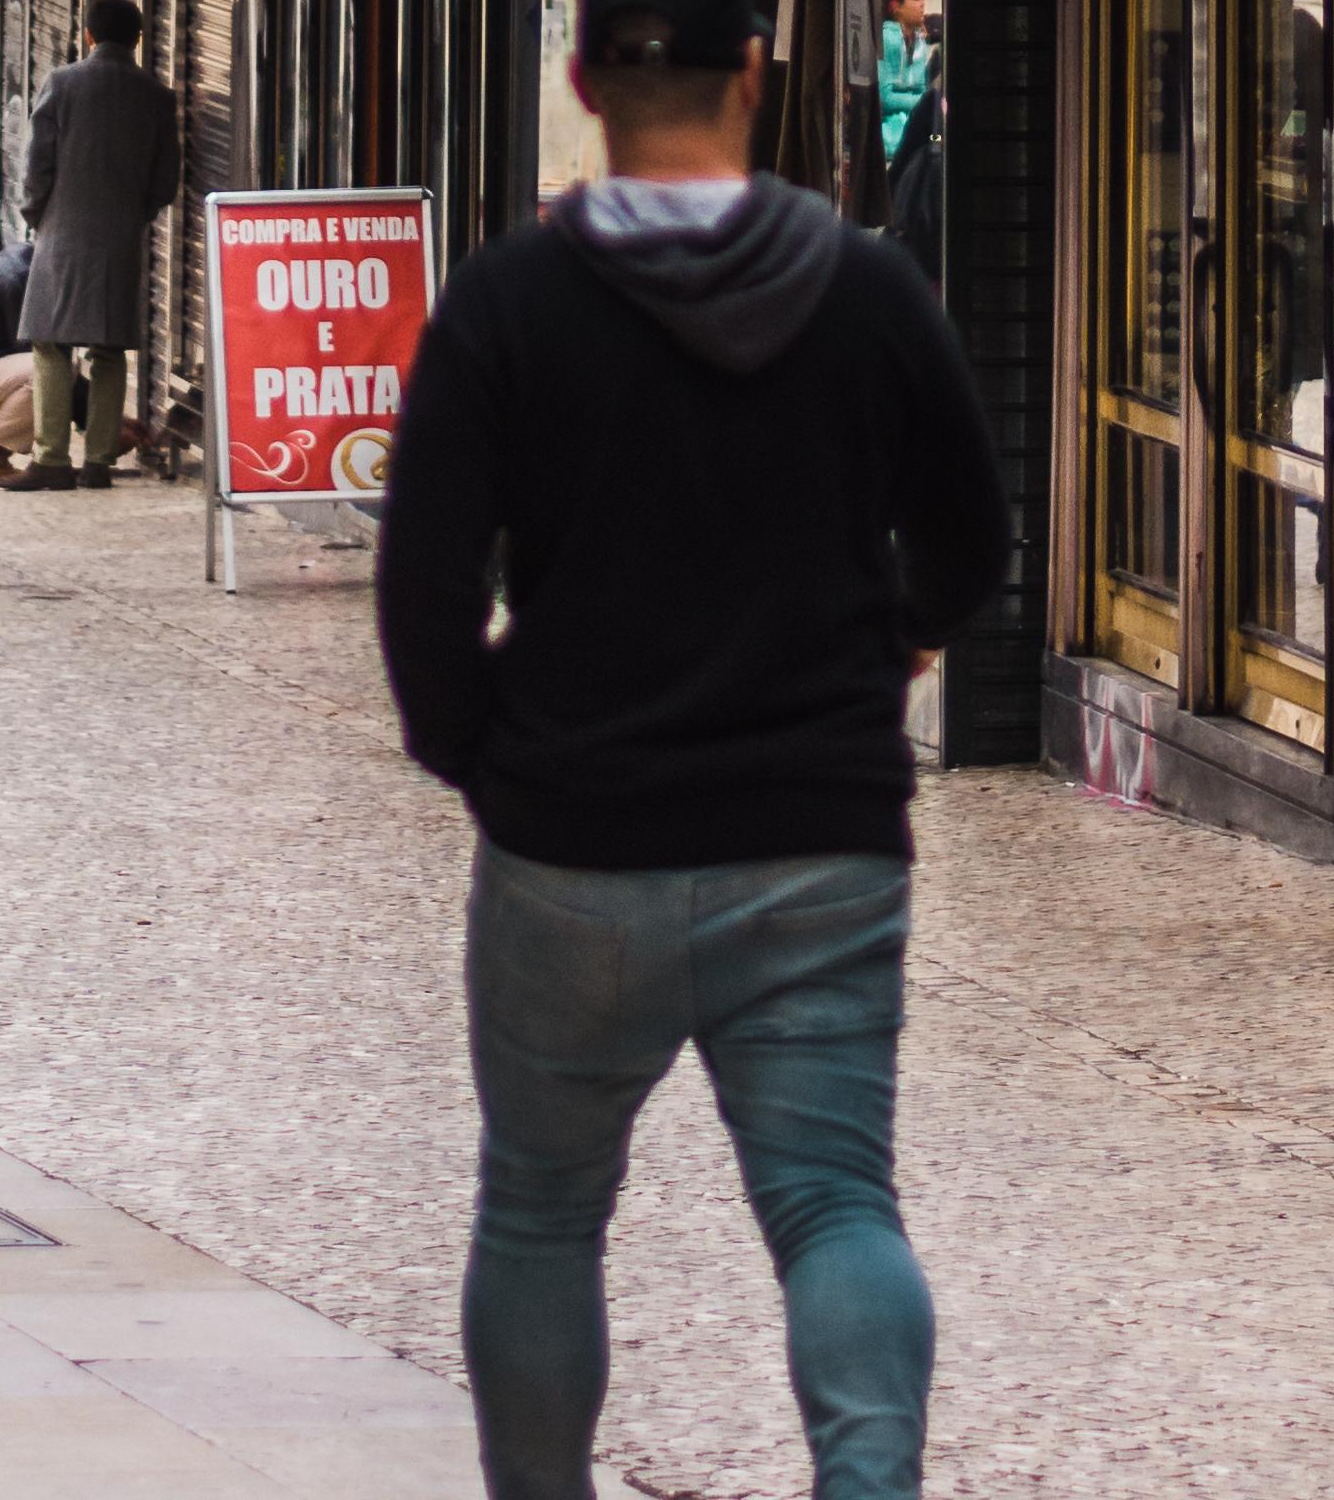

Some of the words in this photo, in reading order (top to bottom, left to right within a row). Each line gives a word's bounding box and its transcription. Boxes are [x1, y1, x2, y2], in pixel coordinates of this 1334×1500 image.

[222, 217, 321, 245] COMPRA
[327, 218, 340, 242] E
[343, 216, 419, 241] VENDA
[256, 258, 390, 312] OURO
[317, 321, 335, 352] E
[253, 365, 402, 418] PRATA
